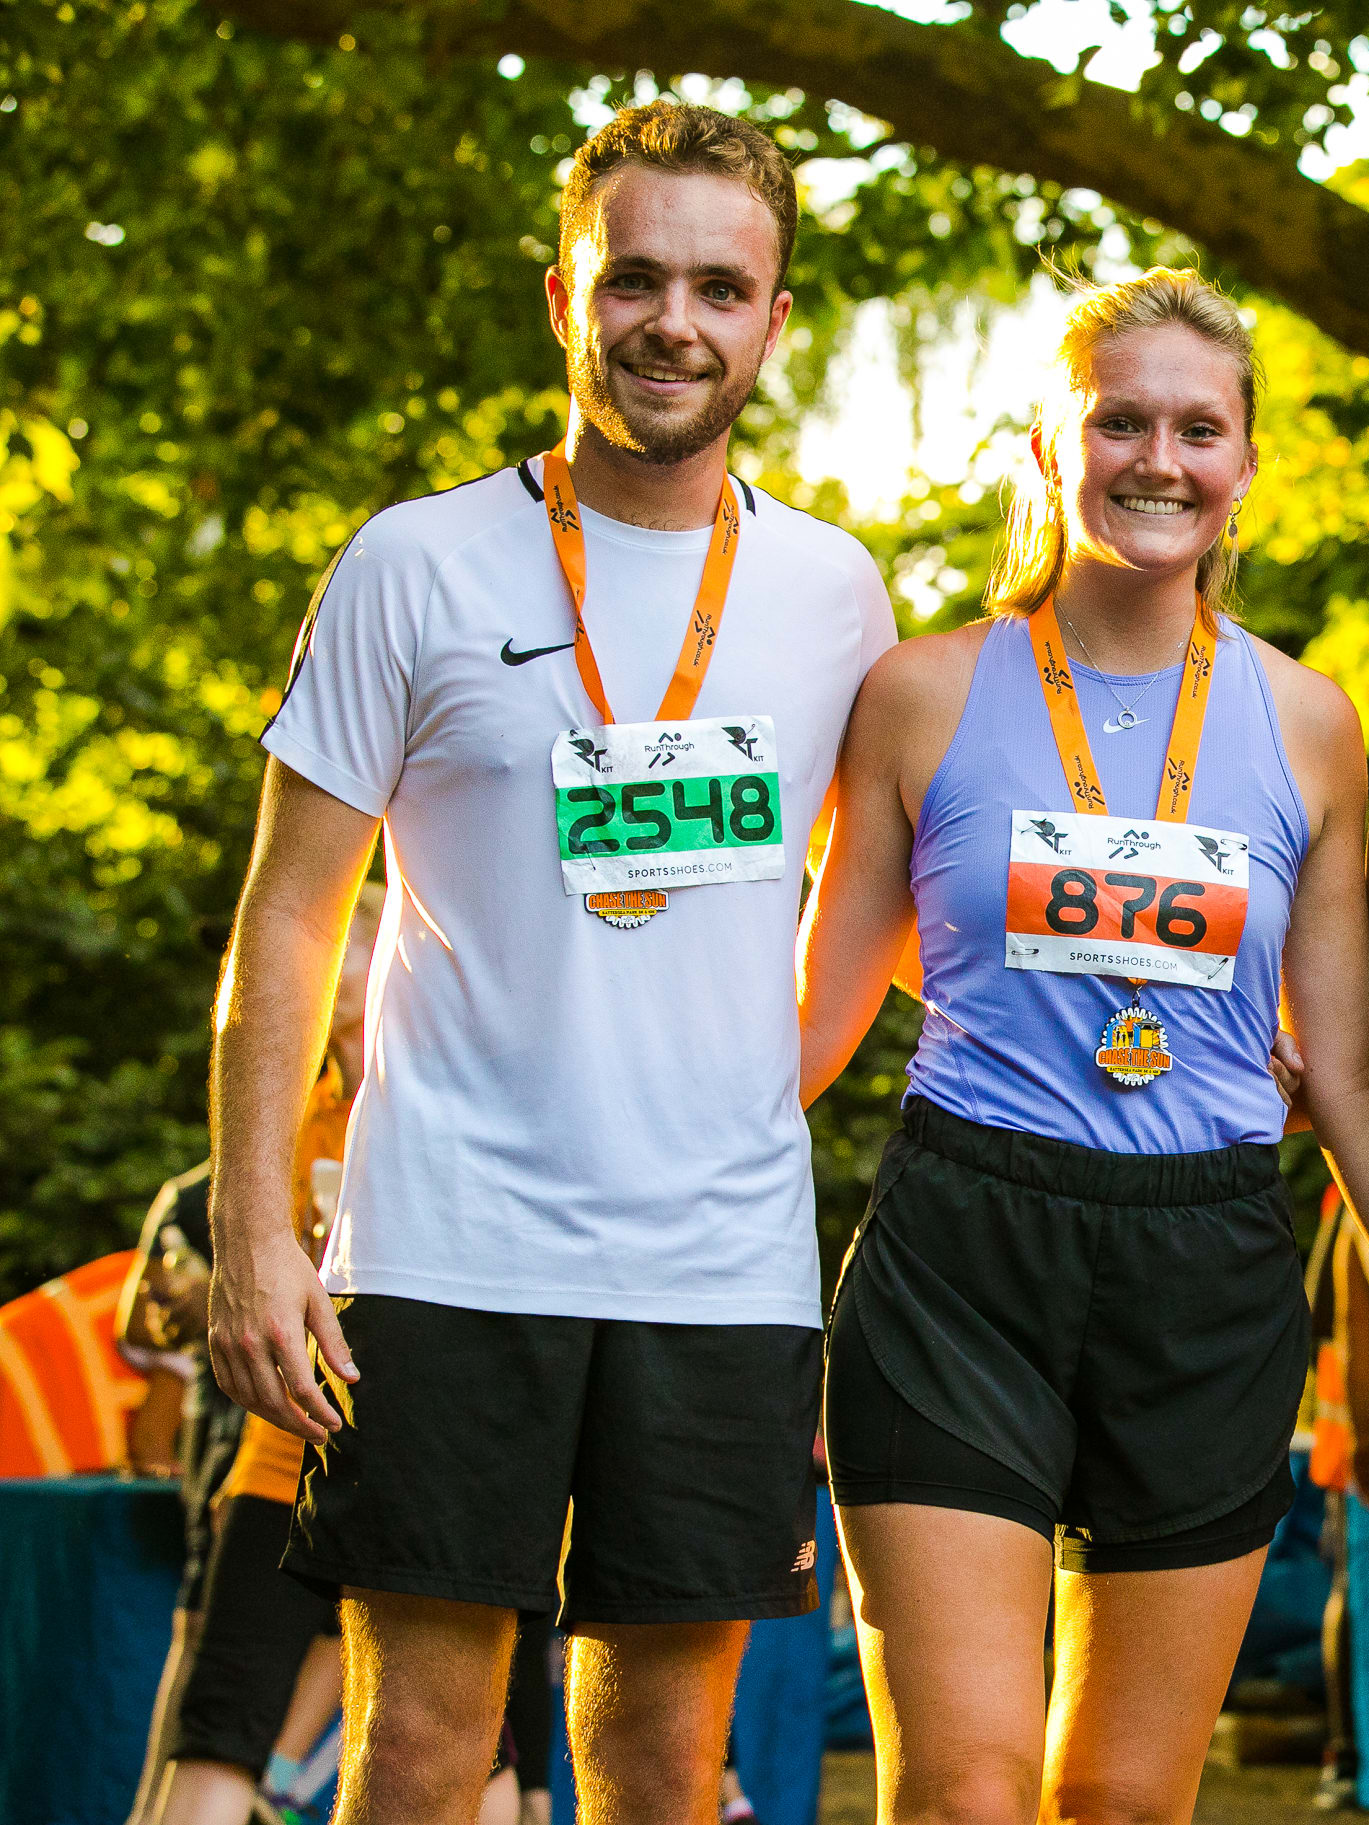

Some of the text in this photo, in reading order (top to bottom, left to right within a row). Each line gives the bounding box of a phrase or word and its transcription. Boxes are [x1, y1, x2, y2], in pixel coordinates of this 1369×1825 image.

[644, 741, 695, 753] RunThrough
[567, 776, 775, 855] 2548
[1107, 837, 1161, 850] RunThrough
[628, 863, 732, 879] SPORTSSHOES.COM
[589, 891, 666, 909] CHASE THE SUN
[1045, 869, 1207, 947] 876
[1069, 952, 1178, 971] SPORTSSHOES.COM
[1098, 1048, 1170, 1068] CHASE THE SUN
